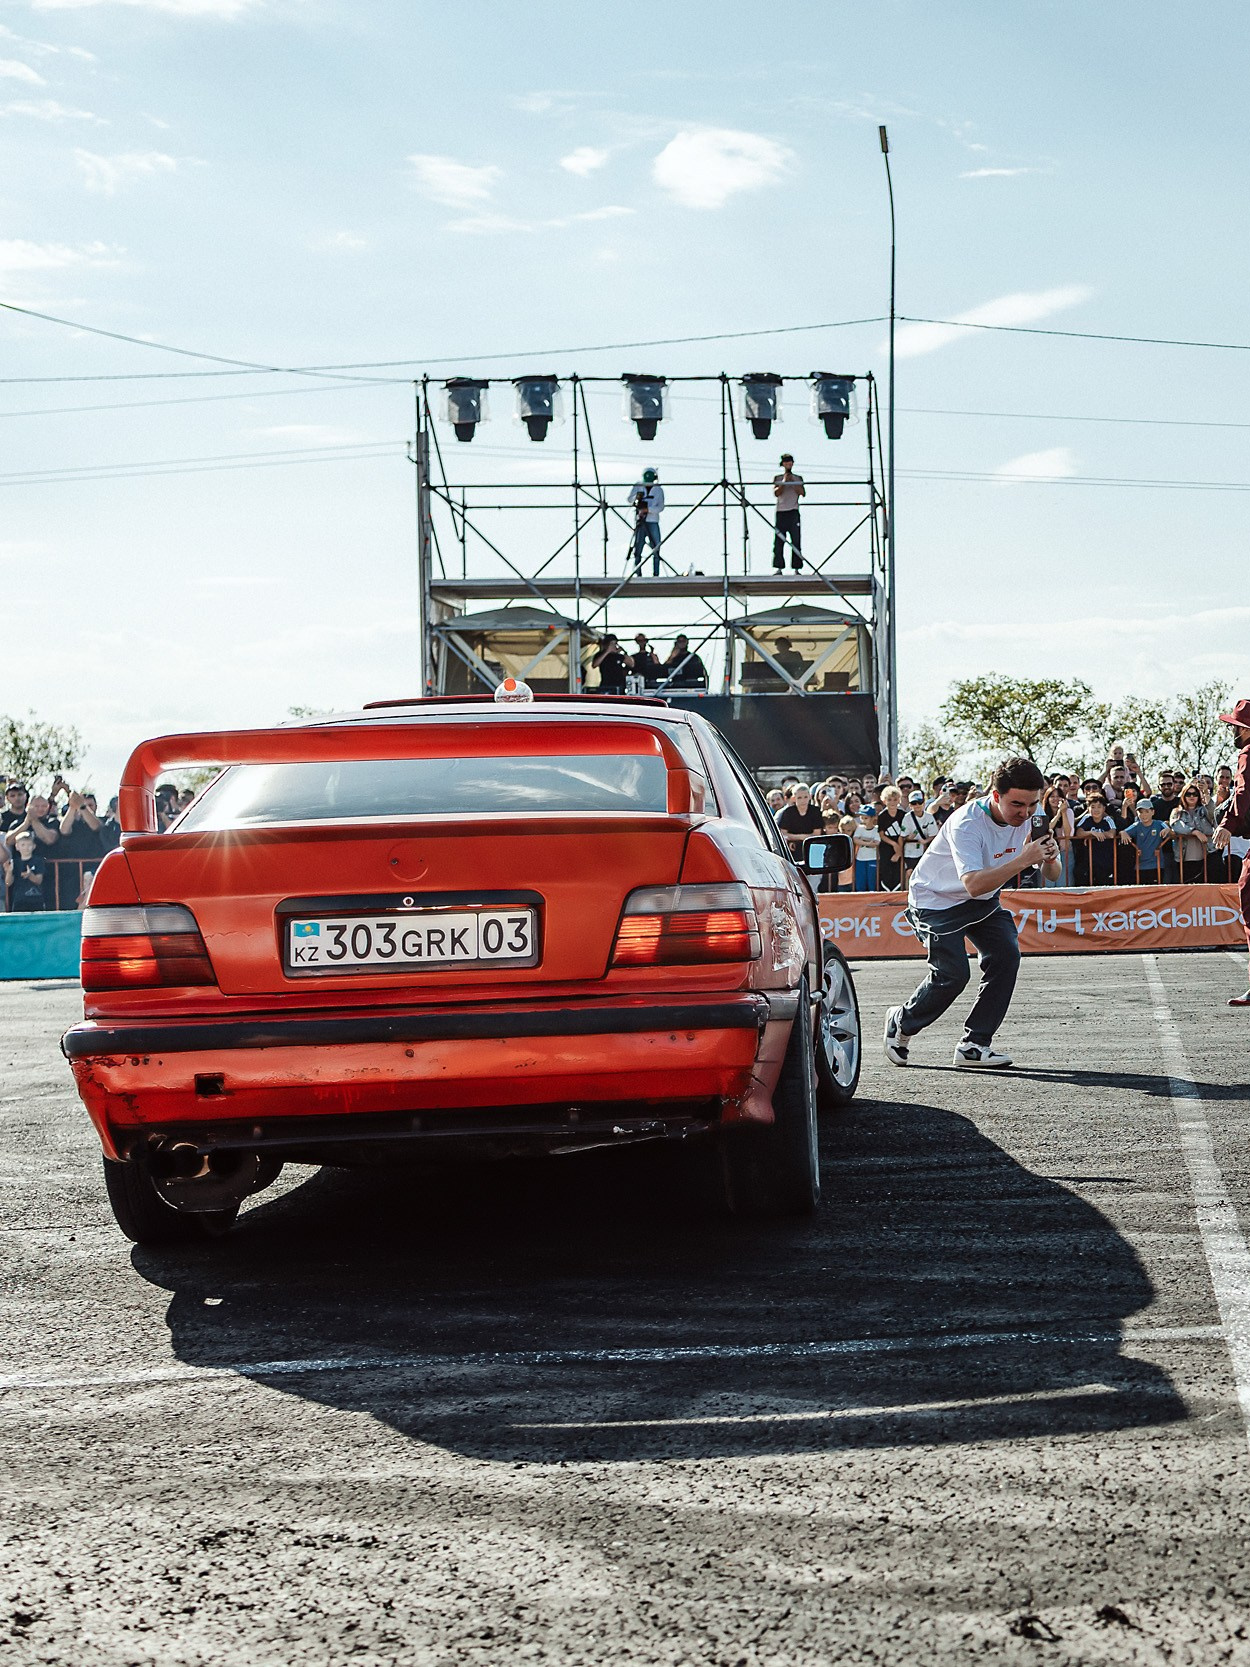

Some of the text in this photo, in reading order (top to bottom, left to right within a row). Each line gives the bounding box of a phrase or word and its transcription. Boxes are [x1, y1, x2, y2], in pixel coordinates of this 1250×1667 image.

[294, 917, 528, 963] KZ 303GRK 03
